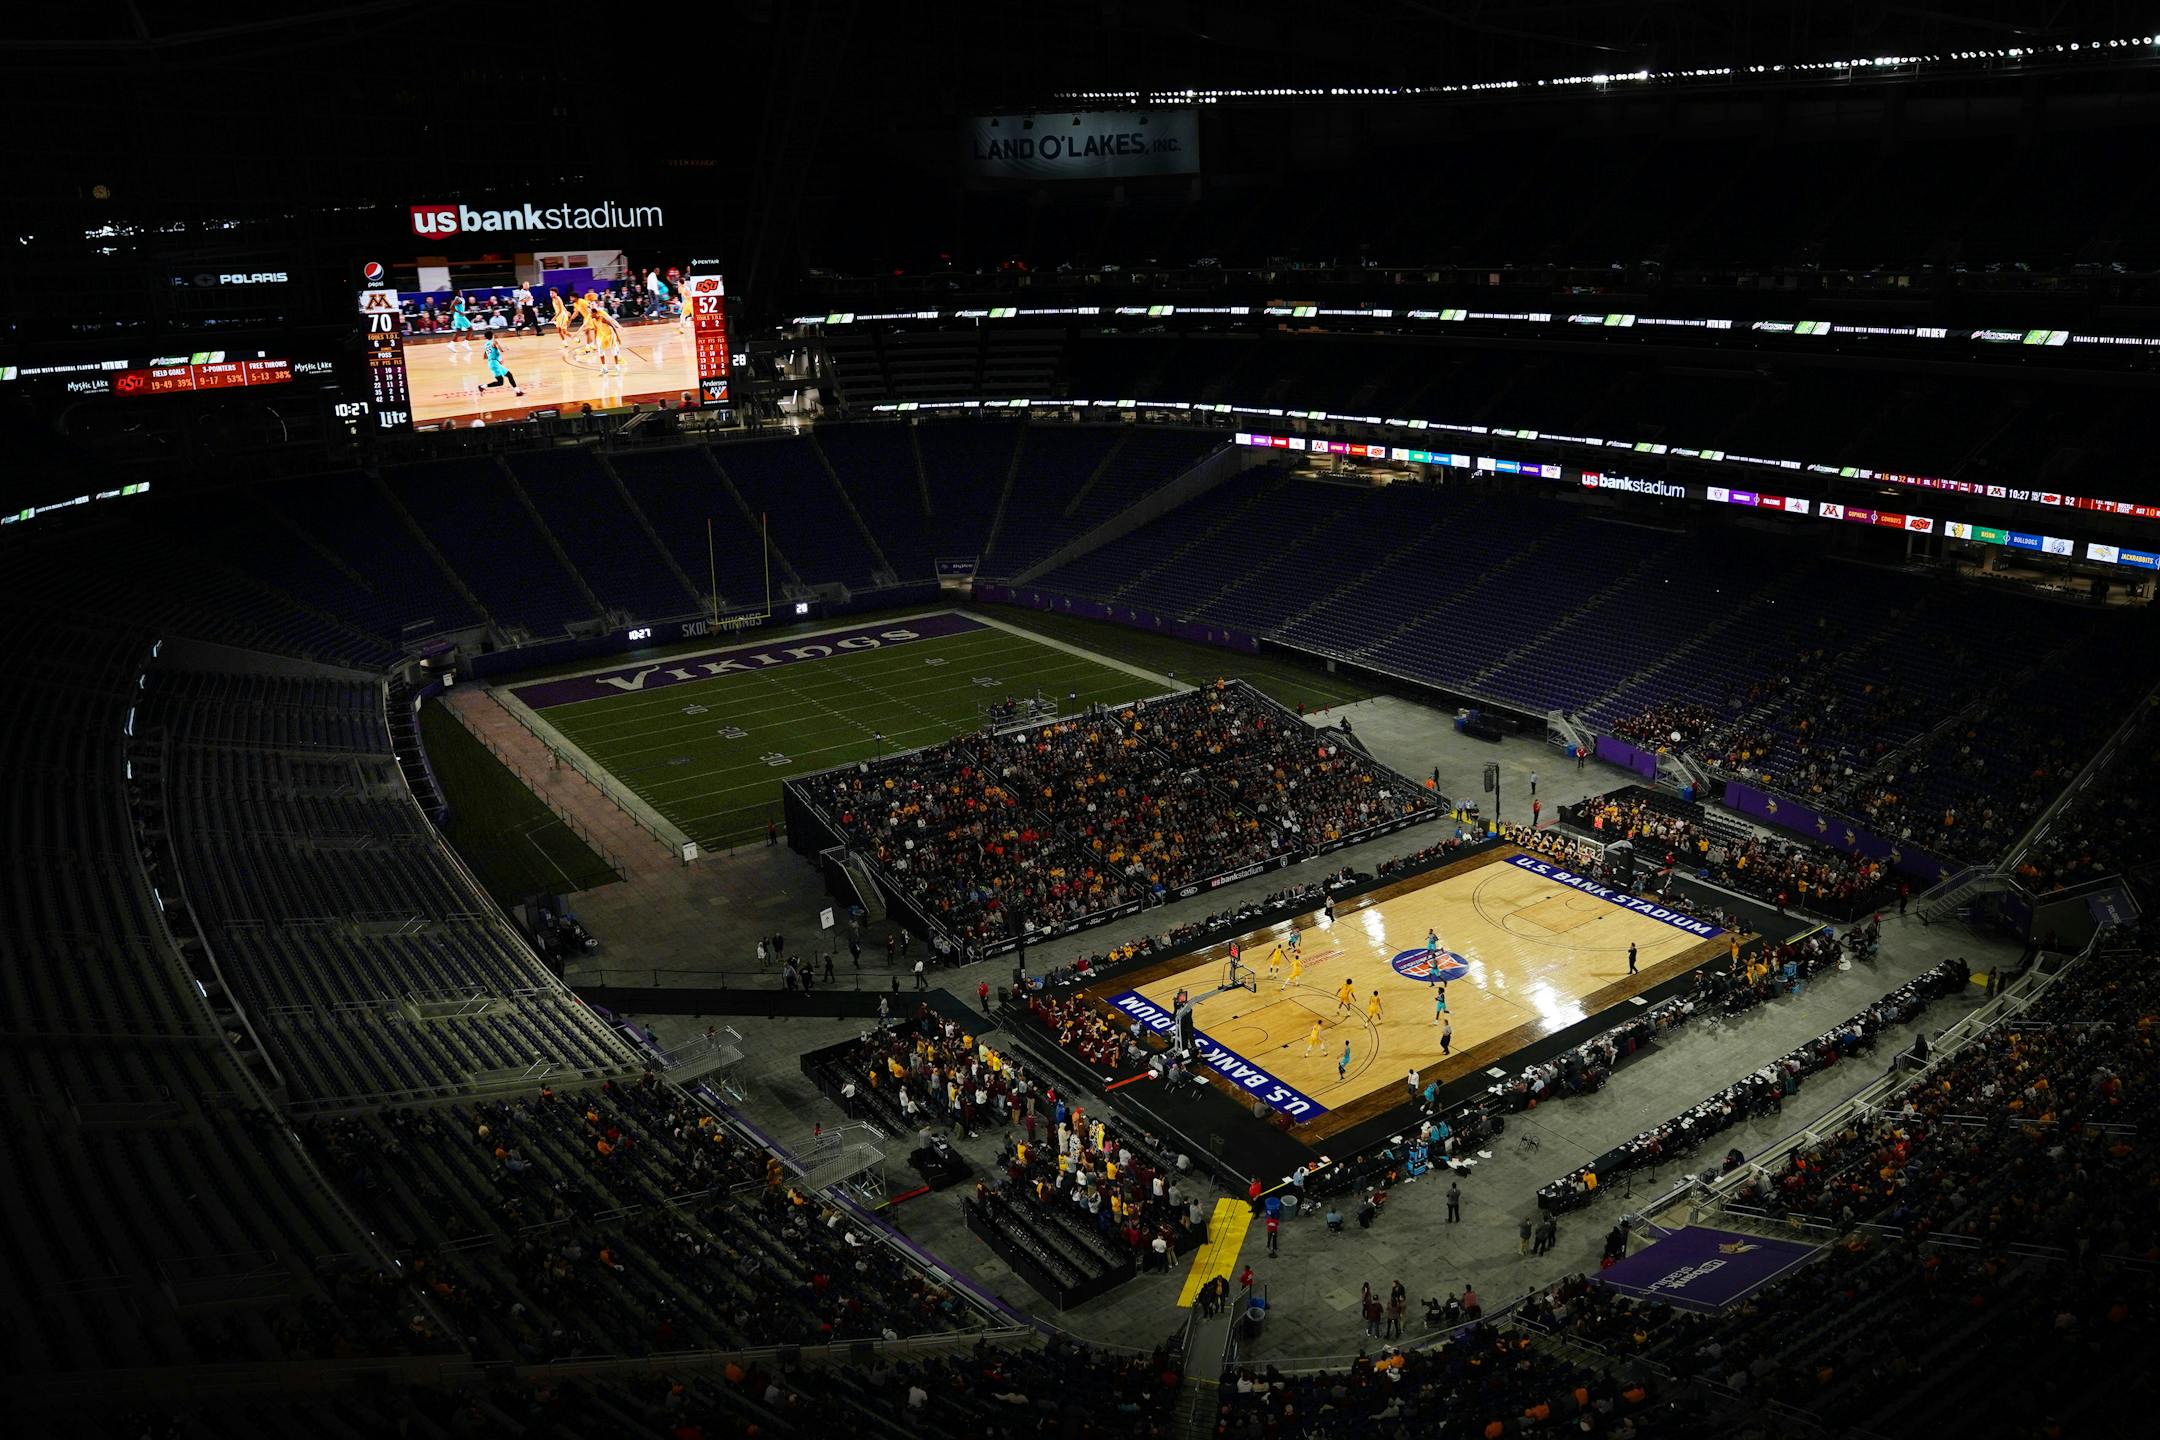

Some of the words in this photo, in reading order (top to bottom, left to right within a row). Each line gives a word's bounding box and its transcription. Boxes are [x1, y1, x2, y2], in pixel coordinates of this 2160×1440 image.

[975, 139, 1034, 160] LAND
[1153, 139, 1182, 153] INC.
[220, 272, 289, 285] POLARIS
[699, 297, 718, 314] 52
[368, 314, 392, 332] 70
[1917, 328, 1931, 338] MTN
[1931, 328, 1948, 338] DEW
[249, 362, 263, 370] FREE
[733, 354, 747, 366] 28
[153, 370, 168, 378] FIELD
[168, 368, 186, 376] GOALS
[202, 365, 237, 373] 3-POINTERS
[200, 376, 218, 385] 9-17
[227, 374, 244, 383] 53%
[252, 372, 270, 381] 5-13
[275, 371, 292, 379] 38%
[151, 380, 173, 390] 19-49
[177, 378, 193, 387] 39%
[702, 380, 727, 388] Andersen
[335, 402, 369, 417] 10:27
[379, 411, 407, 428] Lite
[1882, 473, 1889, 481] 16
[1898, 475, 1906, 483] 32
[1974, 484, 1983, 494] 70
[2009, 489, 2030, 501] 10:27
[2065, 496, 2075, 507] 52
[1848, 511, 1867, 519] GOPHERS
[2146, 508, 2156, 516] 10
[1881, 516, 1902, 525] COWBOYS
[2014, 536, 2038, 546] BULLDOGS
[2121, 553, 2154, 564] JACKRABBITS
[796, 603, 808, 615] 28
[682, 621, 710, 638] SKOL
[720, 612, 763, 631] VIKINGS
[628, 628, 652, 641] 10:27
[595, 629, 920, 691] VIKINGS
[1516, 858, 1552, 874] U.S.
[1553, 872, 1614, 898] BANK
[1612, 895, 1713, 934] STADIUM
[1118, 996, 1209, 1049] SDIUM
[1202, 1047, 1270, 1088] BANK
[1266, 1085, 1311, 1116] U.S.
